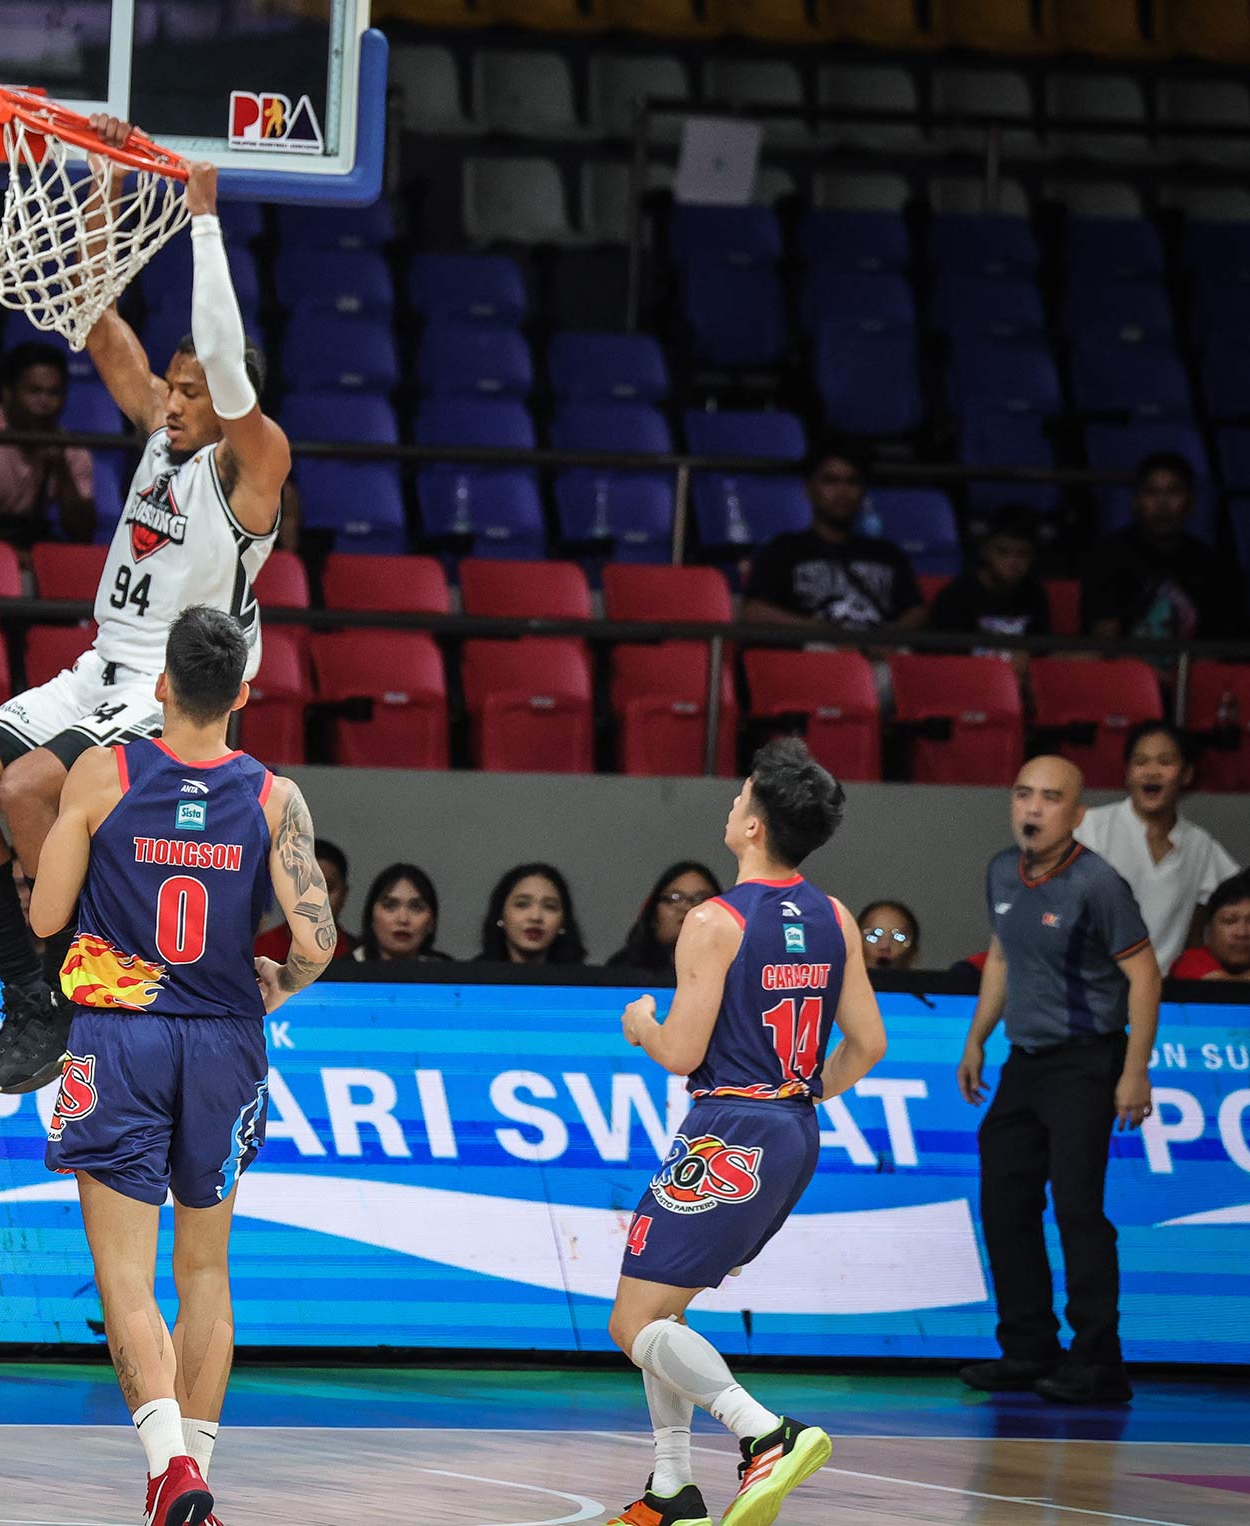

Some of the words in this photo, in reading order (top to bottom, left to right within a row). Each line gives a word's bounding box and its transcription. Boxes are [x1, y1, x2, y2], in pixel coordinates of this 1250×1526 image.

[229, 91, 321, 141] PBA
[110, 565, 152, 617] 94
[180, 807, 202, 819] Sista
[134, 837, 243, 871] TIONGSON
[155, 875, 209, 965] 0
[762, 964, 831, 990] CARACUT
[762, 997, 823, 1081] 14
[673, 1200, 716, 1213] PAINTERS
